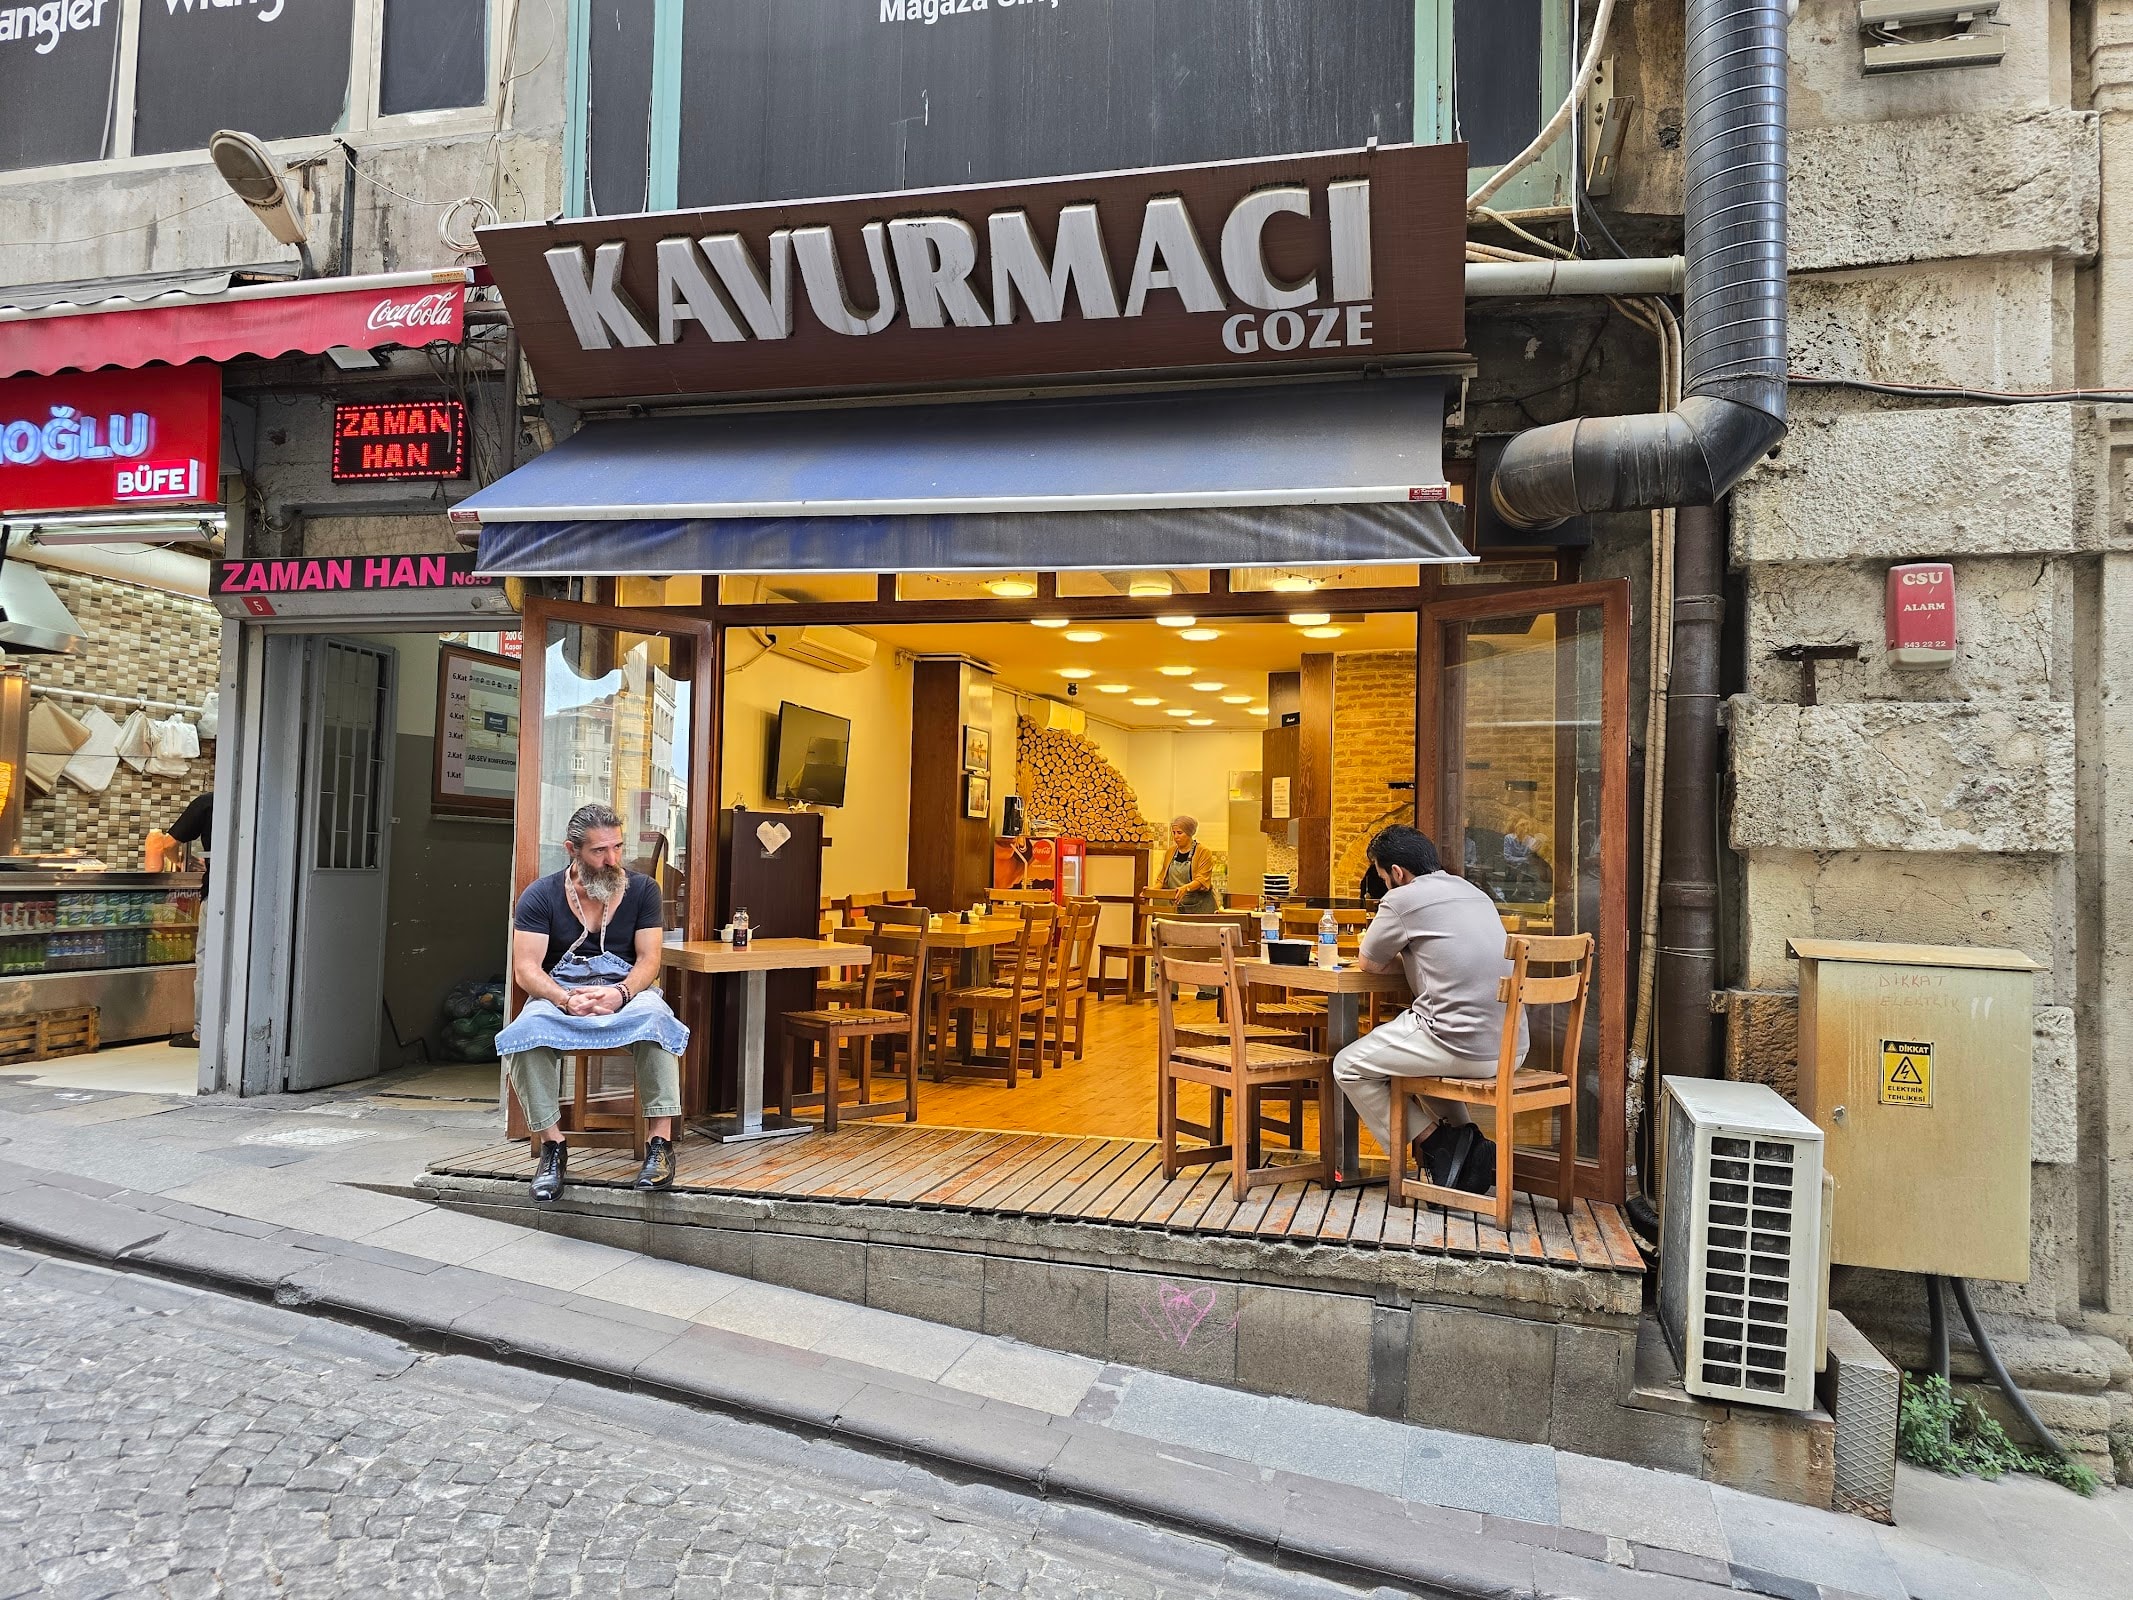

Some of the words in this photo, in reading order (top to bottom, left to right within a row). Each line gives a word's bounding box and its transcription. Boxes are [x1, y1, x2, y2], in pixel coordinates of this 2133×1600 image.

[543, 178, 1374, 351] KAVURMACI
[367, 291, 458, 330] Coca-Cola
[1222, 305, 1373, 354] GOZE
[343, 409, 451, 437] ZAMAN
[0, 405, 150, 465] OĞLU
[361, 442, 430, 469] HAN
[117, 464, 186, 494] BÜFE
[220, 559, 352, 592] ZAMAN
[363, 556, 446, 588] HAN
[1902, 571, 1943, 586] CSU
[253, 601, 263, 612] 5
[1903, 602, 1945, 612] ALARM
[505, 631, 517, 641] 200
[1904, 641, 1920, 649] 543
[1922, 640, 1933, 648] 22
[1935, 640, 1946, 648] 22
[452, 672, 467, 682] 6.Kat
[450, 692, 466, 701] 5.Kat
[449, 712, 465, 721] 4.Kat
[448, 731, 464, 740] 3.Kat
[447, 751, 463, 760] 2.Kat
[446, 770, 462, 779] 1.Kat
[1879, 972, 1947, 988] DİKKAT
[1898, 1044, 1930, 1055] DİKKAT
[1887, 1085, 1925, 1094] ELEKTRİK
[1887, 1094, 1926, 1103] TEHLİKESİ
